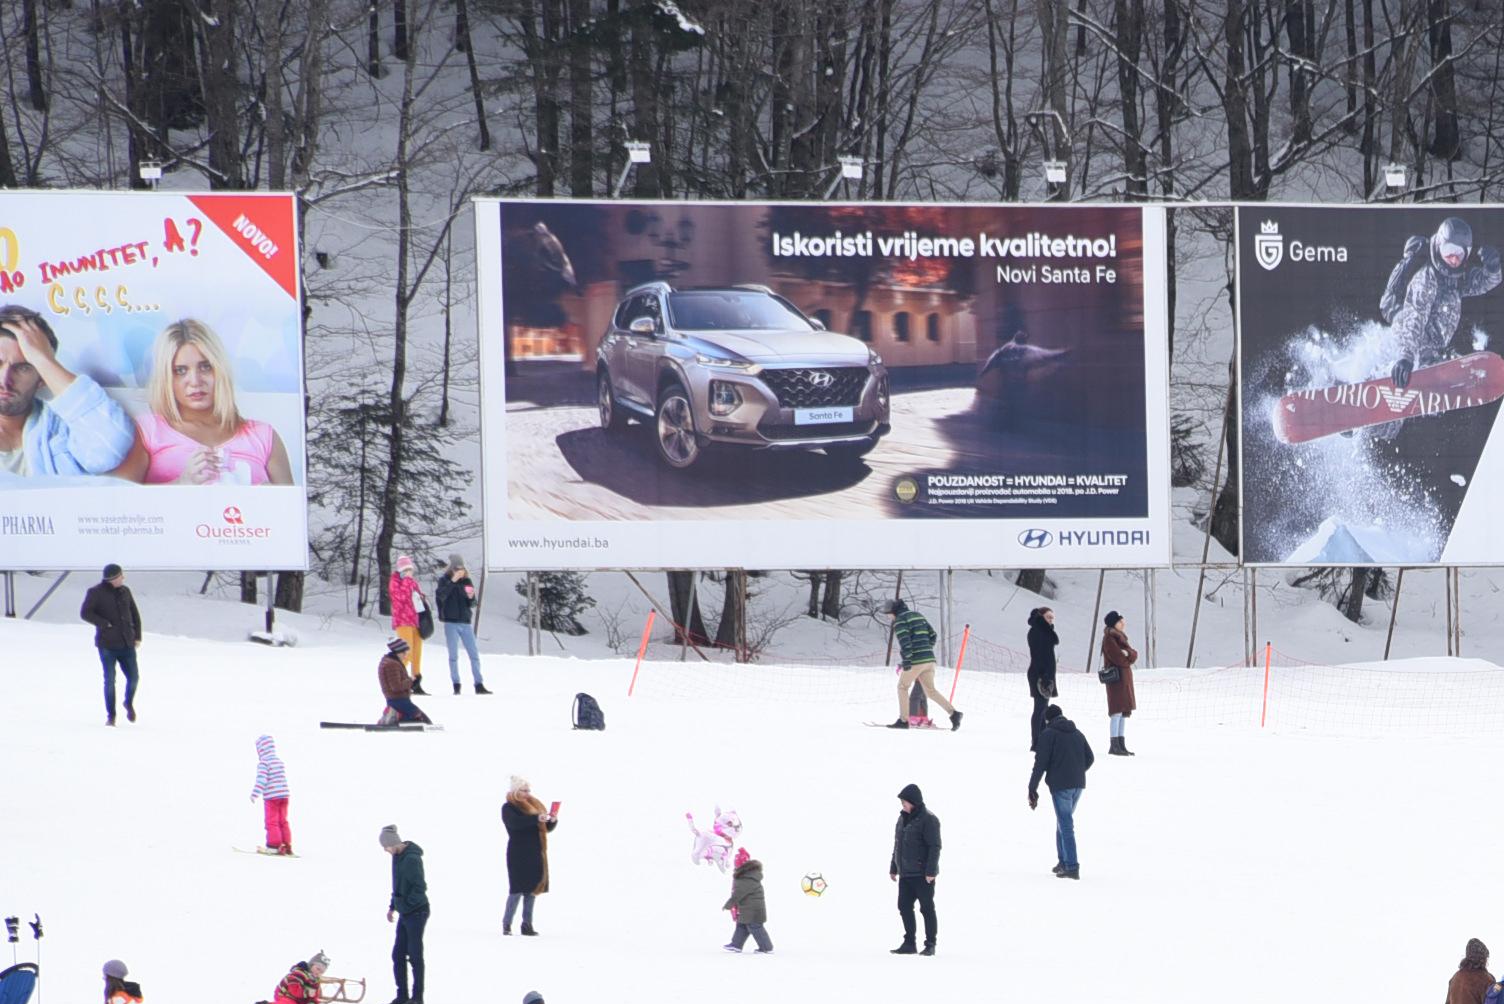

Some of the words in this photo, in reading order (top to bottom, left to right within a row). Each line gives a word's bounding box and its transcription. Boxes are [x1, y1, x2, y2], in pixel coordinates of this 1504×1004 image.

[163, 217, 202, 256] A?
[232, 213, 279, 259] NOVO!
[773, 231, 873, 257] Iskoristi
[877, 231, 975, 261] vrijeme
[980, 232, 1116, 257] kvalitetno!
[1289, 241, 1348, 262] Gema
[996, 265, 1036, 283] Novi
[1041, 265, 1091, 283] Santa
[1096, 265, 1116, 283] Fe
[808, 411, 833, 421] Santa
[833, 411, 844, 419] Fe
[927, 475, 1005, 487] POUZDANOST
[1014, 475, 1067, 486] HYUNDAI
[1076, 474, 1128, 486] KVALITET
[2, 516, 55, 535] PHARMA
[195, 523, 272, 539] Queisser
[507, 537, 609, 550] www.hyundai.ba
[1059, 530, 1150, 546] HYUNDAI
